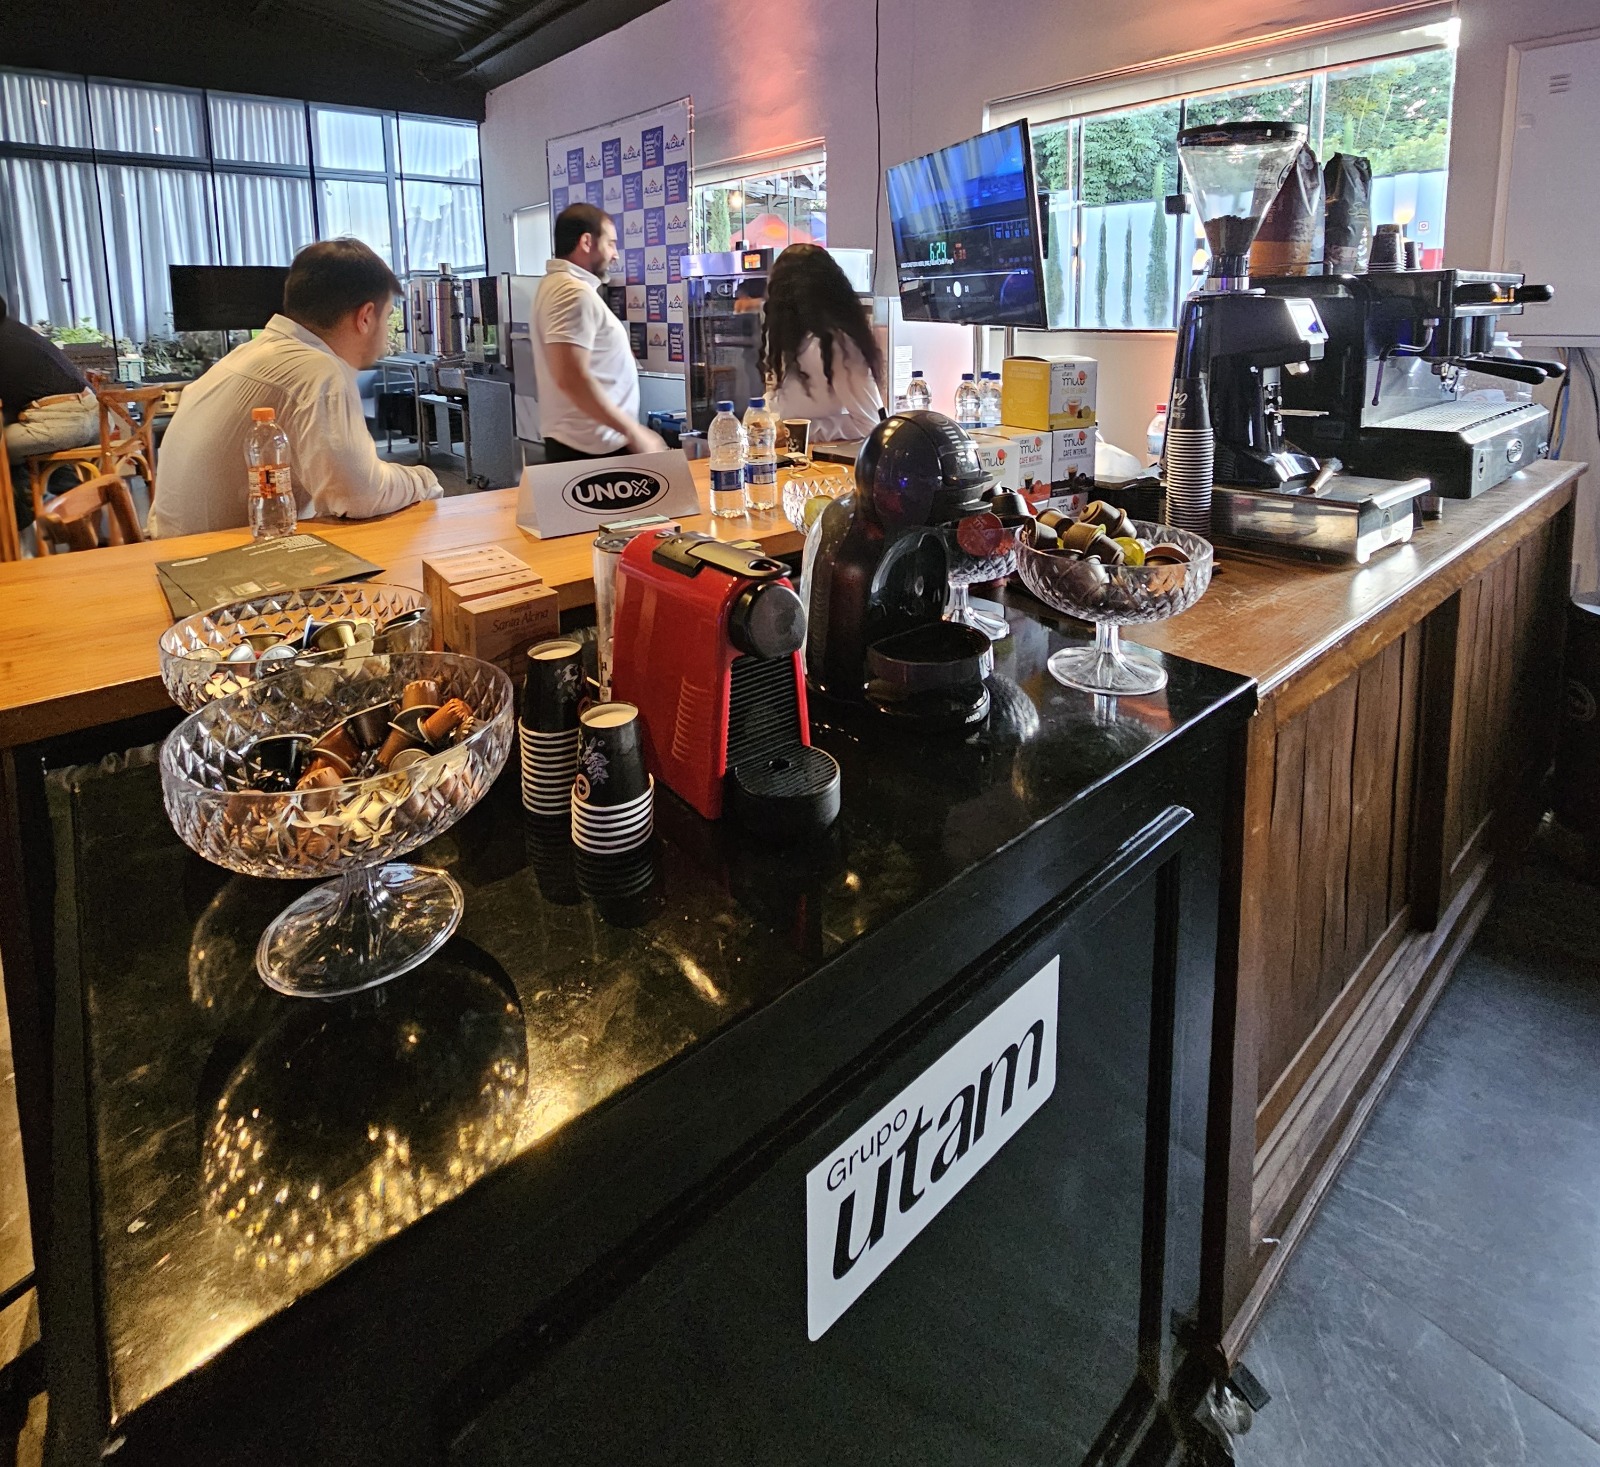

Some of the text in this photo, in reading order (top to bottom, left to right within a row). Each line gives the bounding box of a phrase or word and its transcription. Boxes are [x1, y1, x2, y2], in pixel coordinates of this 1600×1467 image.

[575, 478, 651, 503] UNOX
[827, 1108, 908, 1192] Grupo
[832, 1018, 1044, 1280] utam
